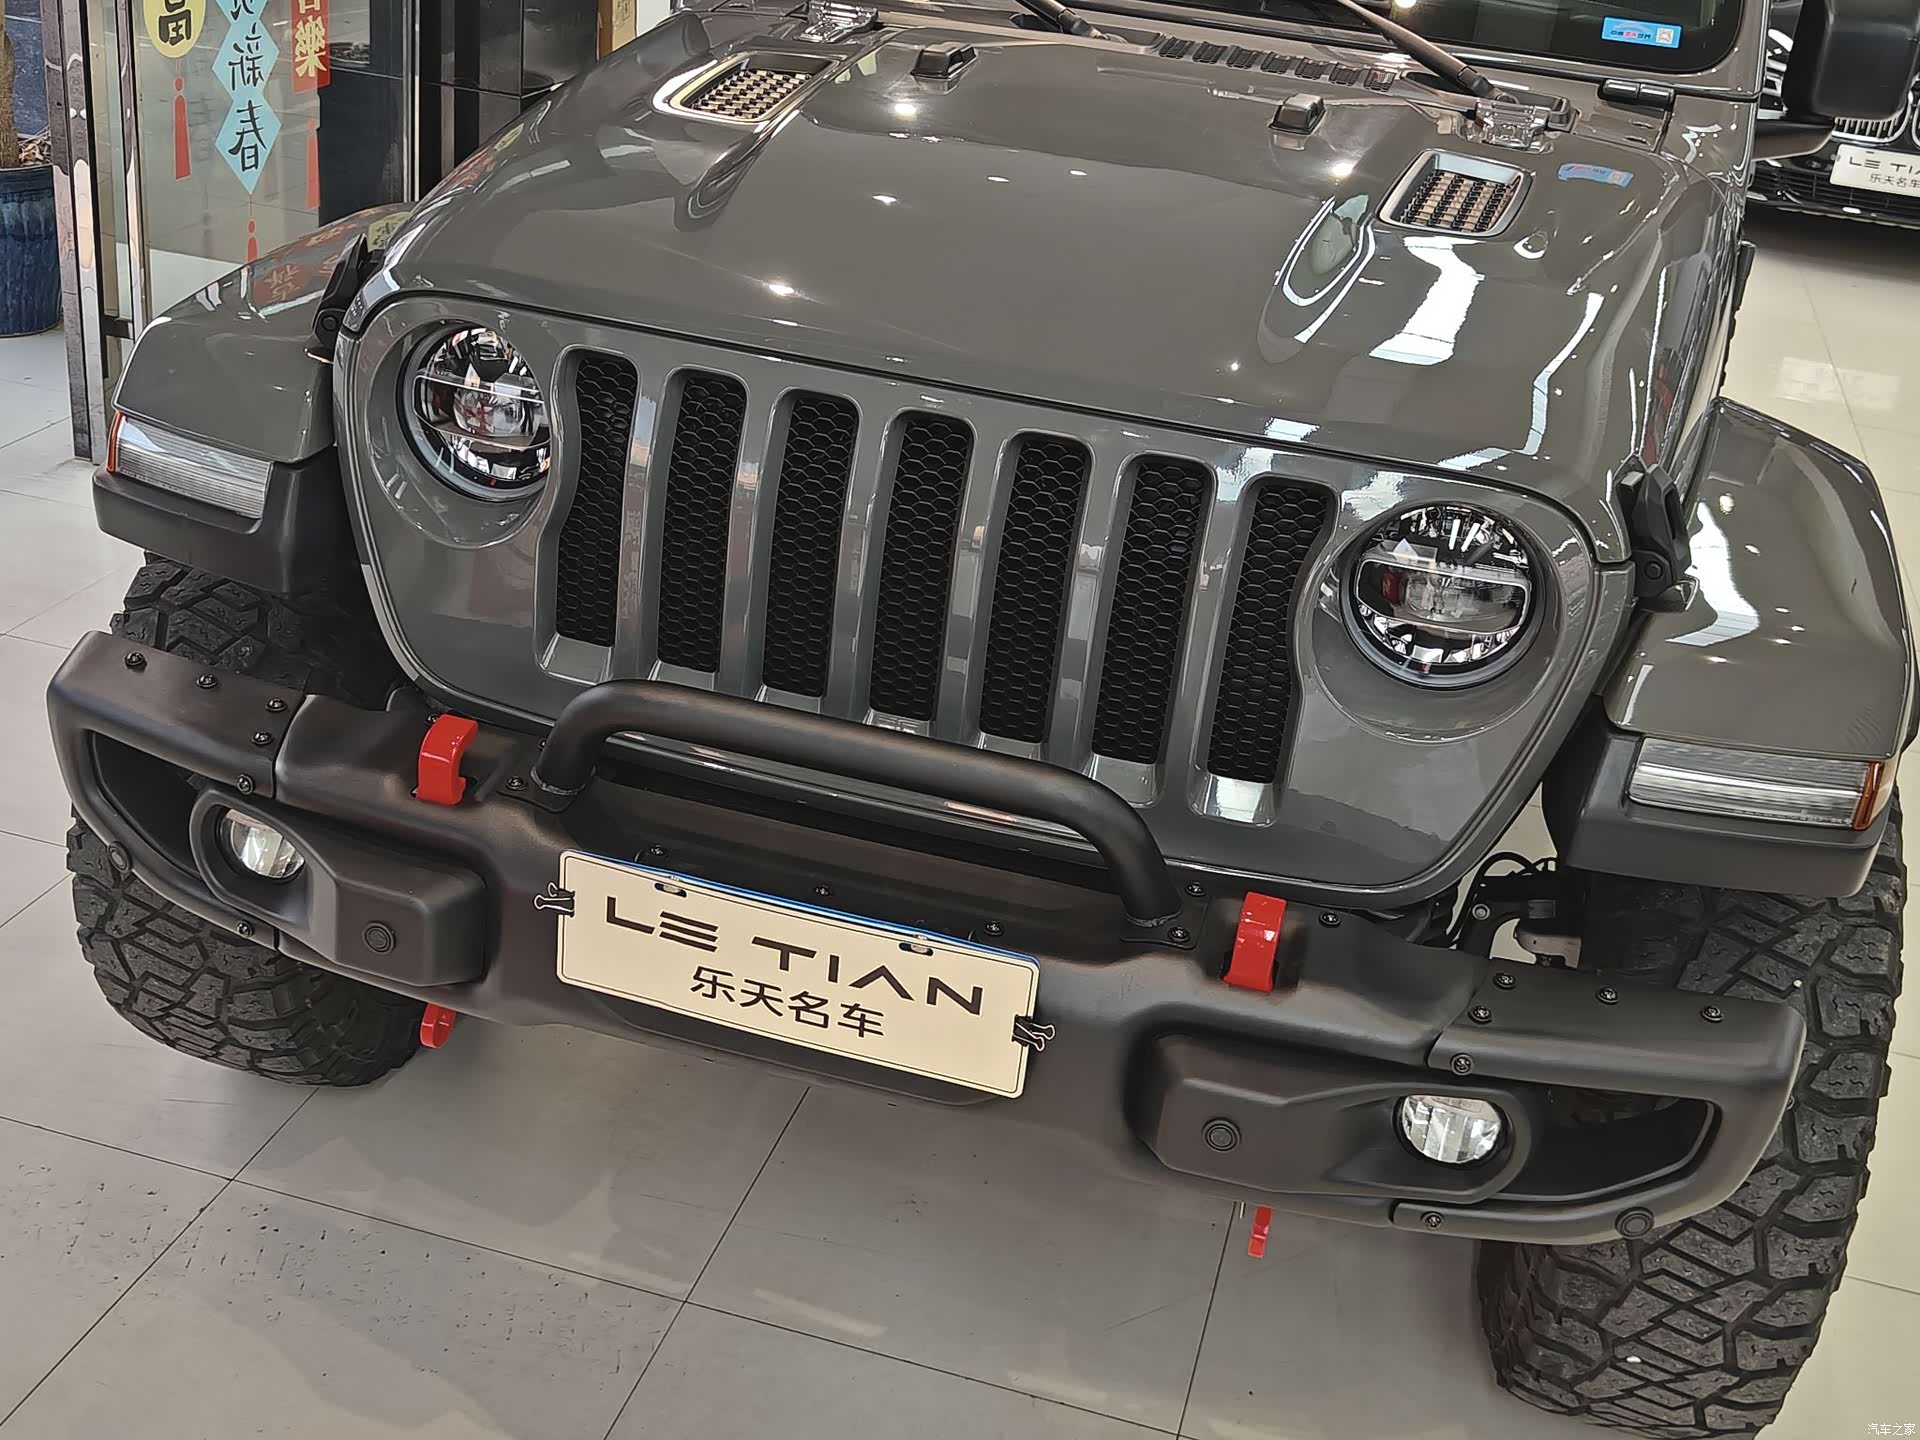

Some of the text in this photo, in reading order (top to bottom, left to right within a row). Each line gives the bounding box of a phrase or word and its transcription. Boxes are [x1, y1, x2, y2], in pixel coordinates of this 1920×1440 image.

[1849, 156, 1881, 170] LE
[605, 896, 984, 1016] LE TIAN
[689, 965, 885, 1038] 乐天名车
